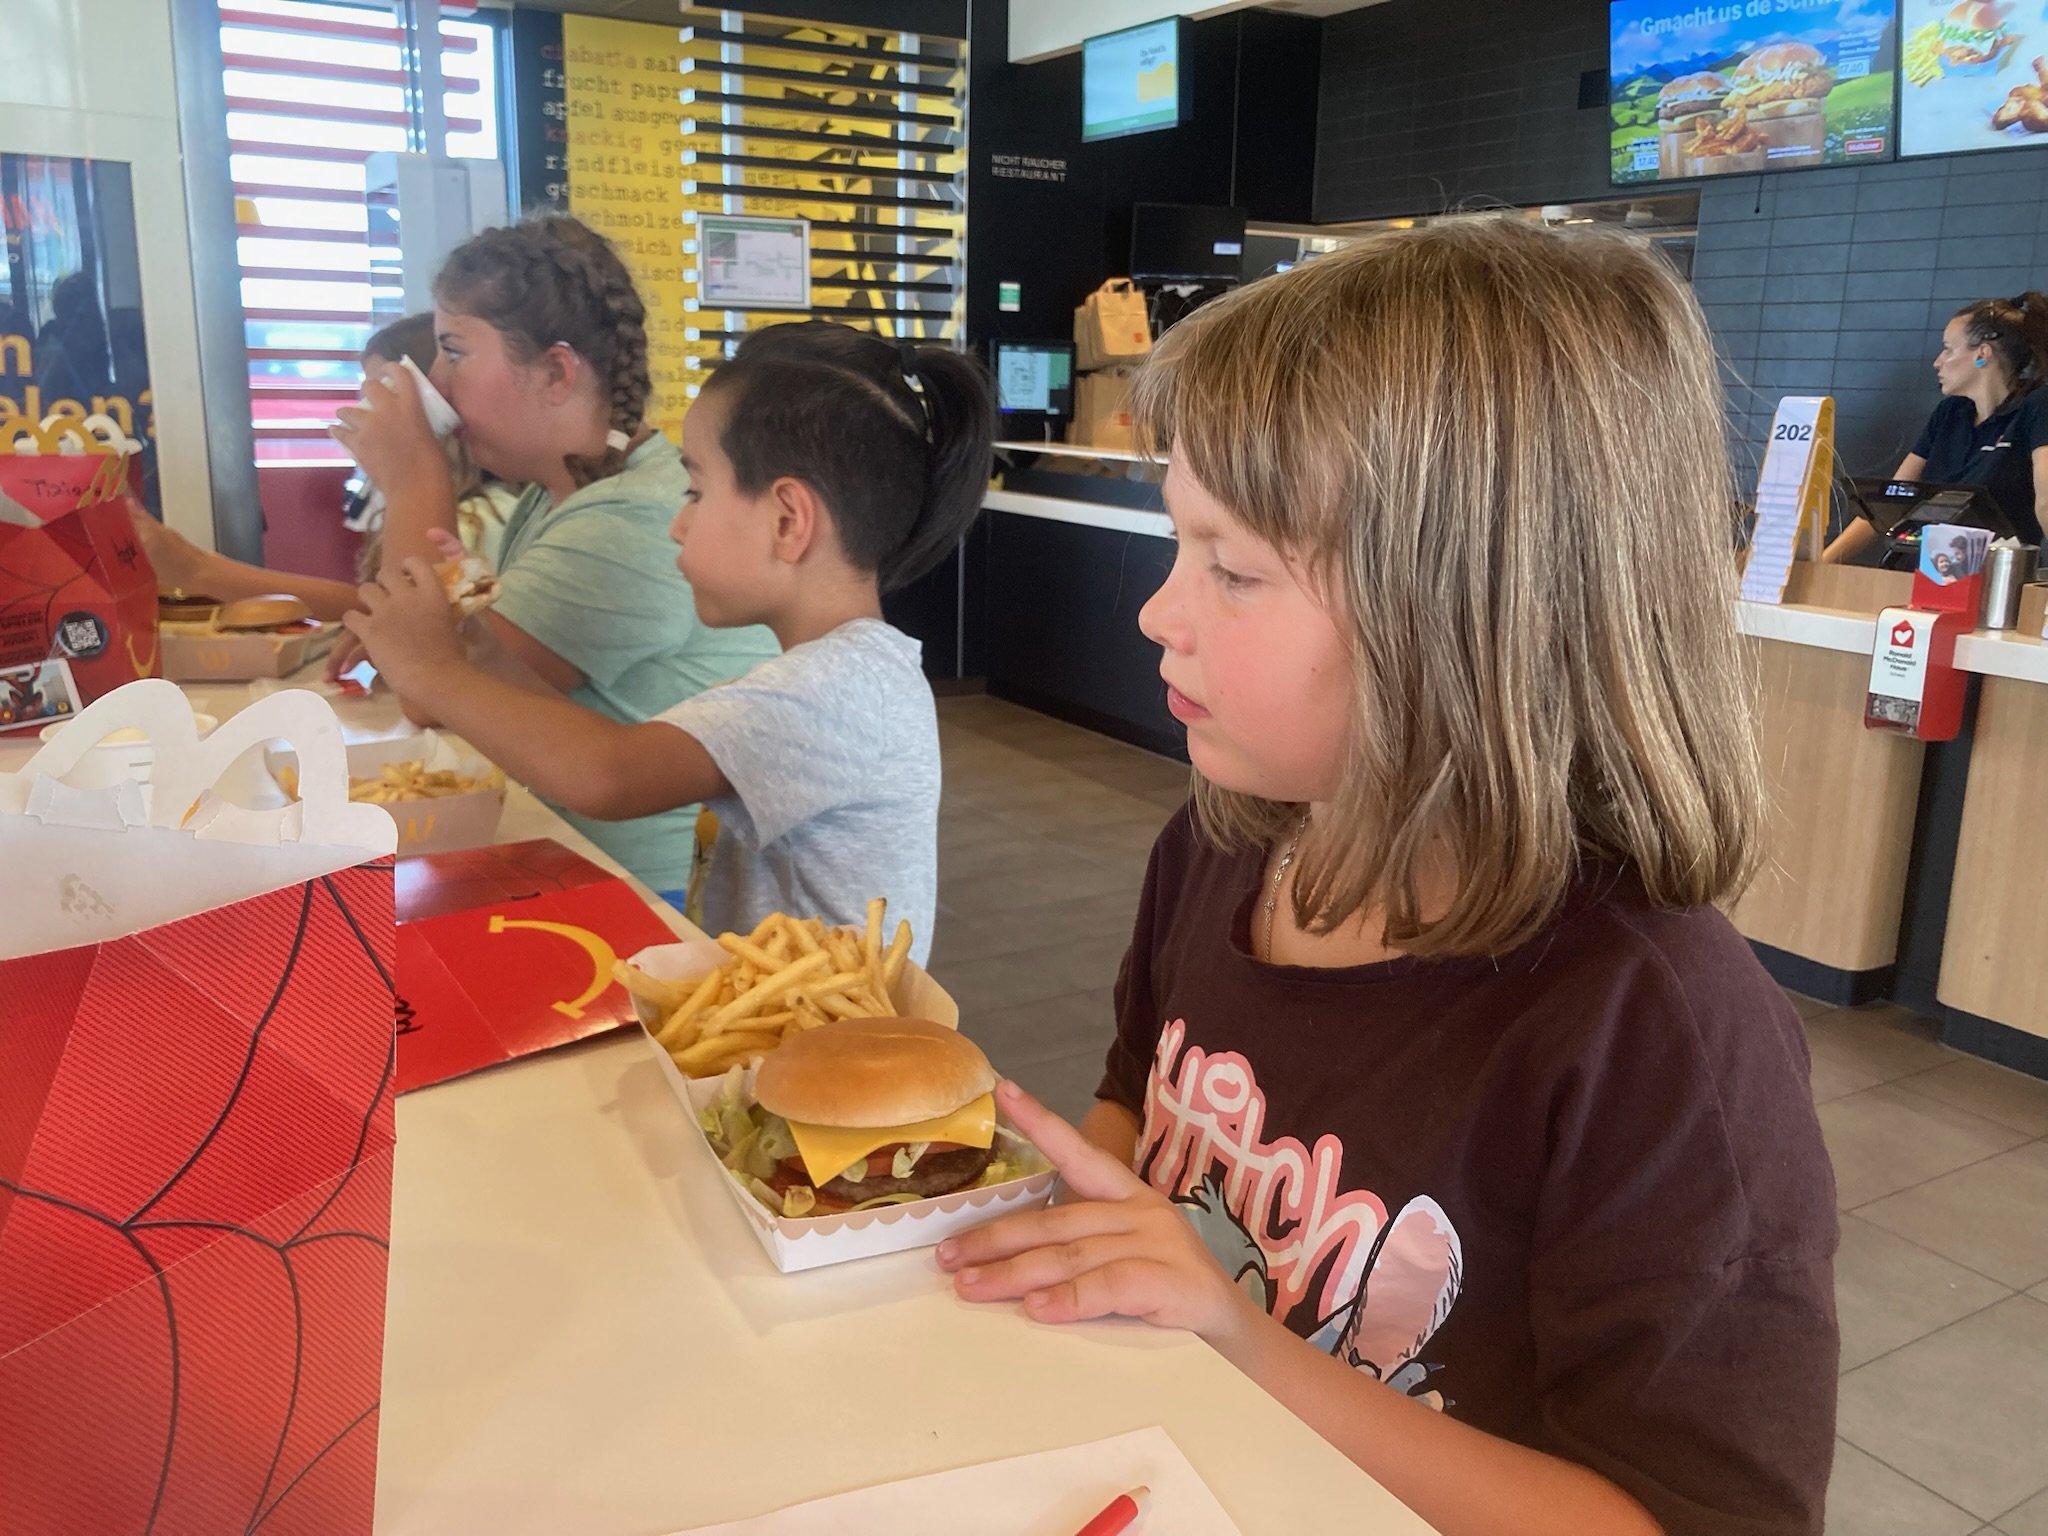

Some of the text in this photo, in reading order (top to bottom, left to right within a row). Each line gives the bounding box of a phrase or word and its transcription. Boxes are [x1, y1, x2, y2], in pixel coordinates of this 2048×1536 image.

[1640, 8, 1715, 37] Gmacht
[1718, 3, 1742, 25] us
[1746, 0, 1771, 18] de
[991, 166, 1067, 182] RESTAURANT
[1774, 424, 1812, 441] 202
